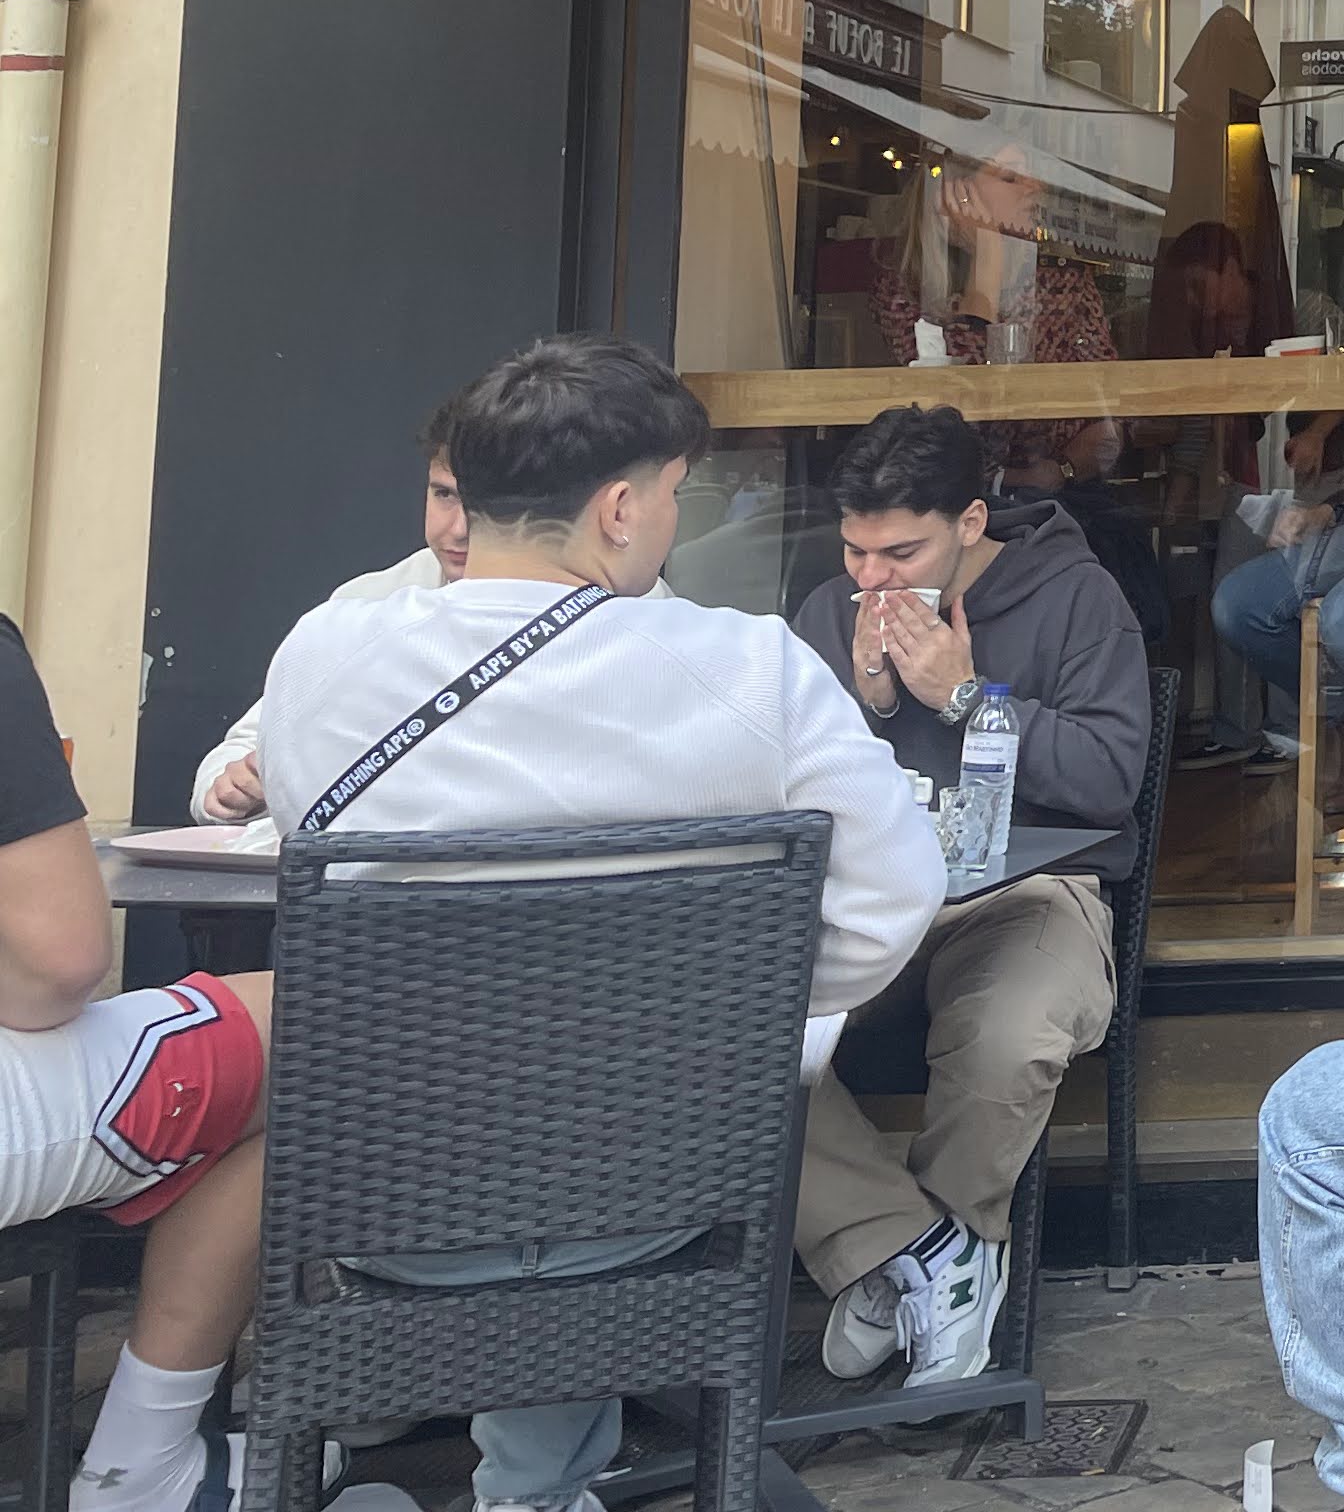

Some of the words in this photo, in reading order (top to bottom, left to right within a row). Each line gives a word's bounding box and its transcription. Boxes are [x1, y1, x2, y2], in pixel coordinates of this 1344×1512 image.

[467, 651, 512, 690] AAPE
[551, 586, 608, 626] BATHING
[330, 751, 386, 805] BATHING
